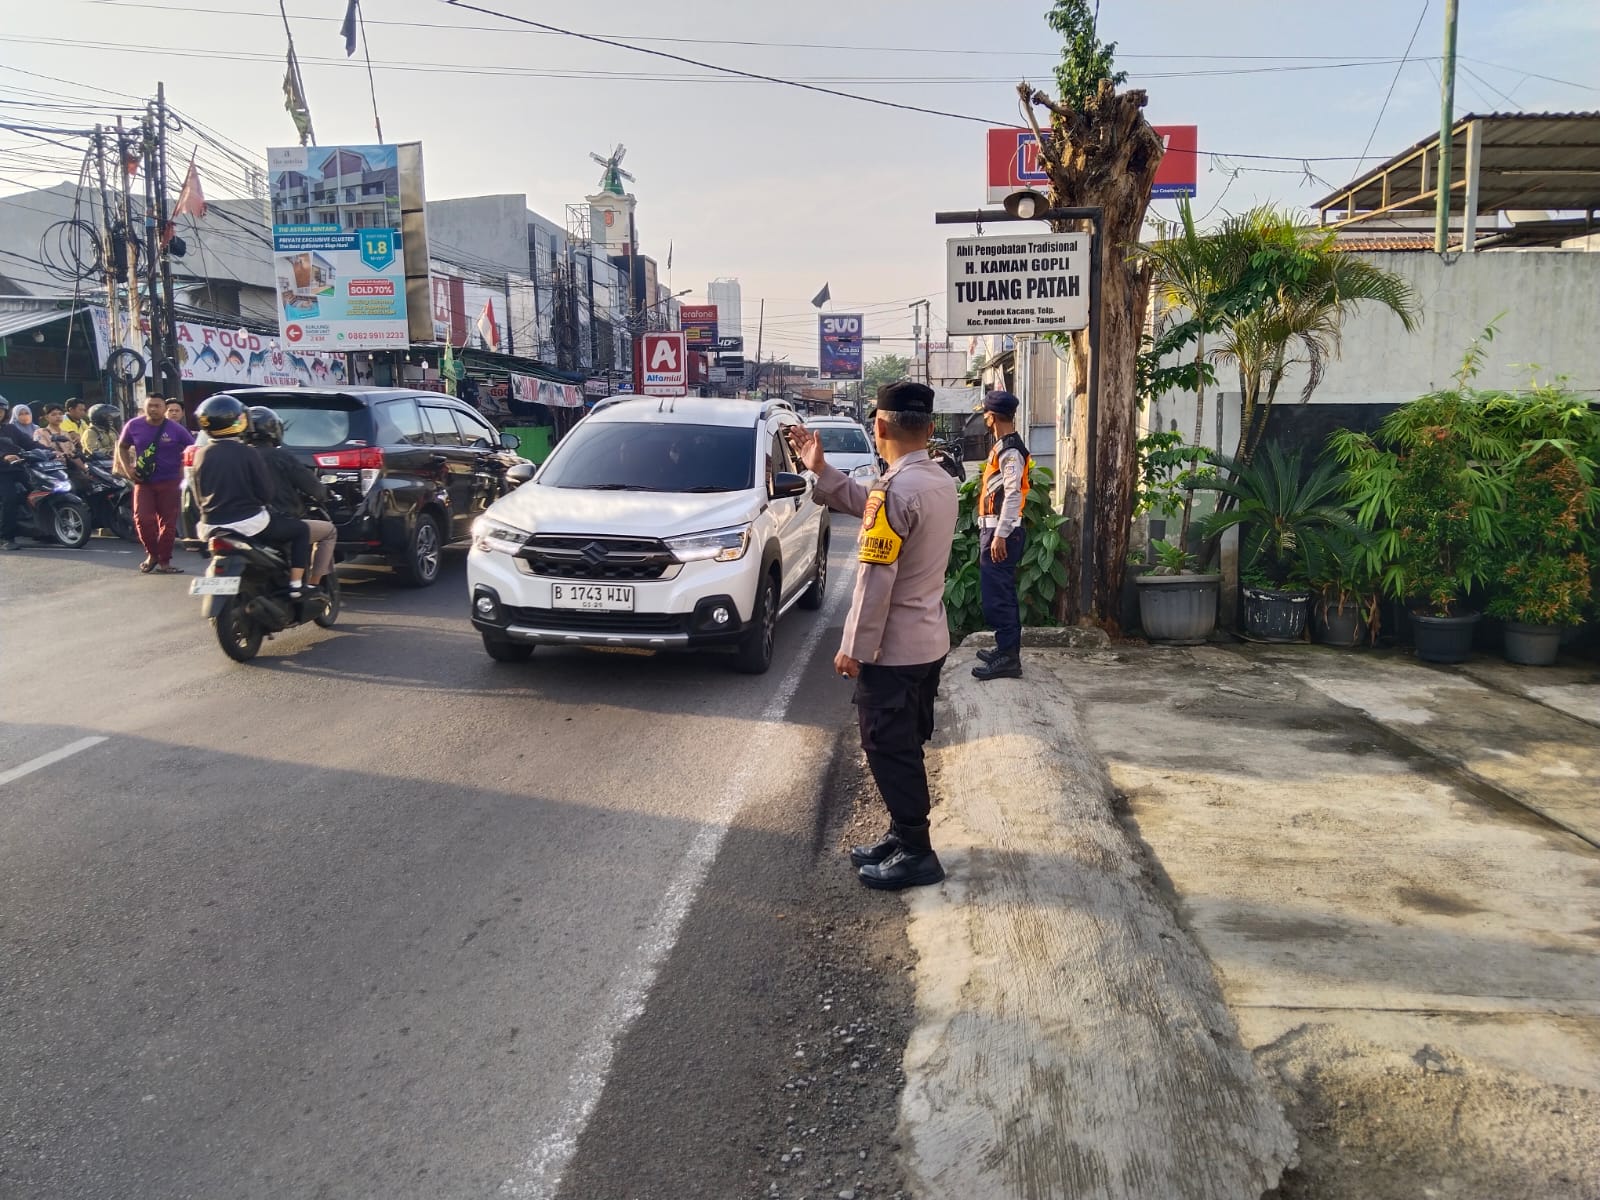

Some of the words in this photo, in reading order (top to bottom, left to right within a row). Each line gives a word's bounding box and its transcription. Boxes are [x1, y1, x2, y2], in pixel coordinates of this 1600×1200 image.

[366, 241, 388, 255] 1.8
[956, 245, 974, 257] Ahli
[975, 242, 1027, 257] Pengobatan
[1028, 240, 1078, 254] Tradisional
[965, 261, 978, 275] H.
[980, 259, 1028, 274] KAMAN
[1031, 257, 1070, 272] GOPLI
[351, 286, 374, 294] SOLD
[374, 286, 393, 294] 70%
[955, 278, 1022, 303] TULANG
[1026, 275, 1080, 299] PATAH
[682, 310, 714, 318] erafone
[977, 307, 1005, 316] Pondok
[1037, 306, 1055, 315] Telp.
[967, 318, 982, 326] Kec.
[984, 317, 1012, 326] Pondok
[1012, 317, 1031, 325] Aren
[1036, 315, 1066, 325] Tangsel
[202, 328, 261, 351] FOOD
[646, 374, 681, 382] Alfamidi
[555, 585, 563, 599] B
[570, 586, 602, 601] 1743
